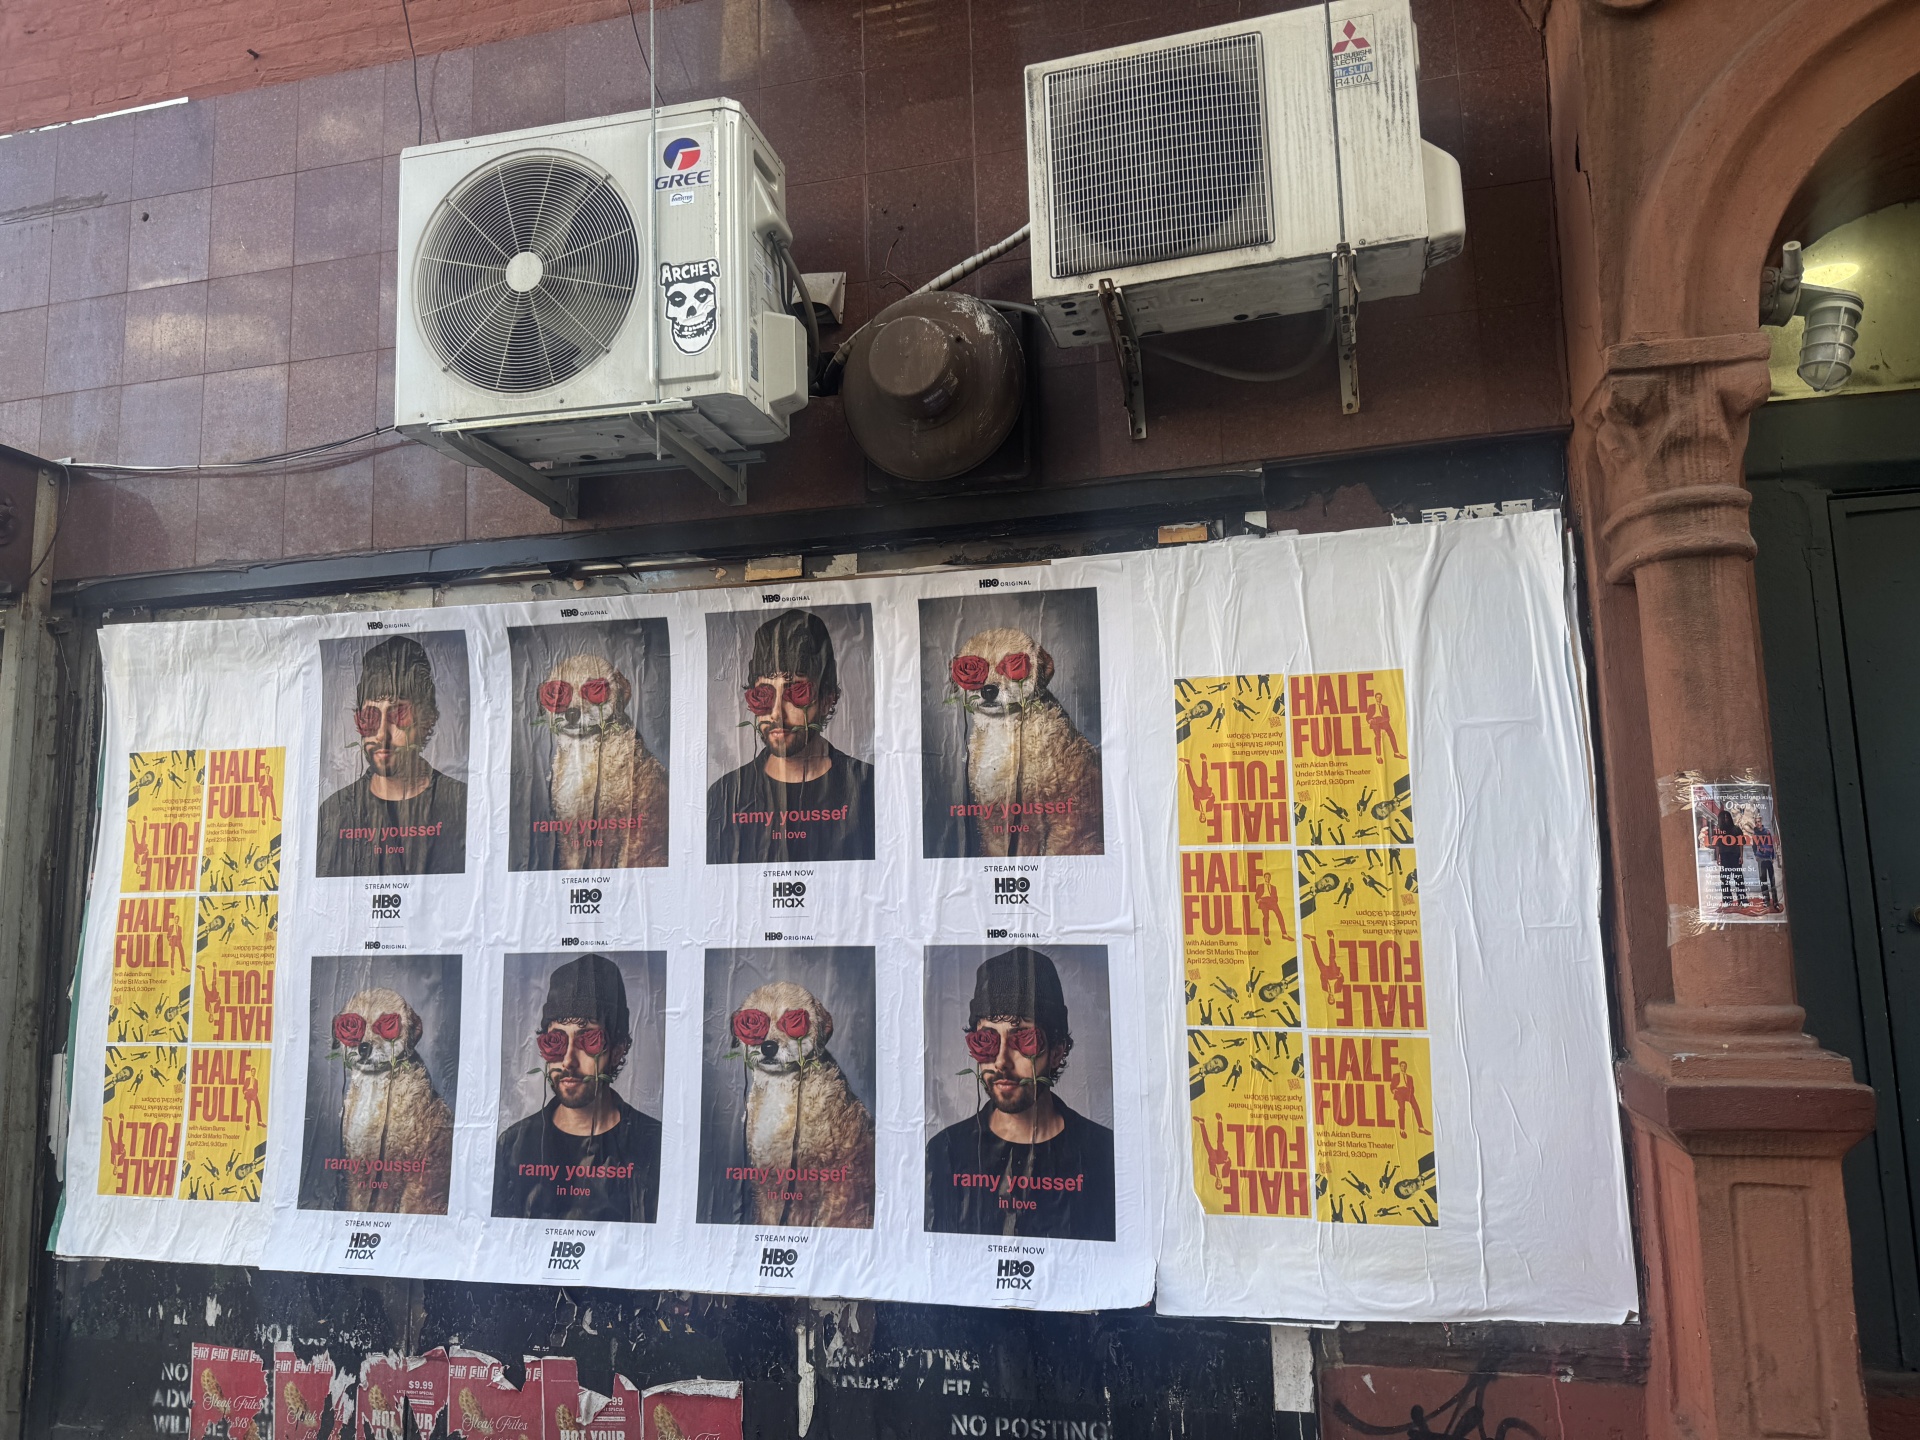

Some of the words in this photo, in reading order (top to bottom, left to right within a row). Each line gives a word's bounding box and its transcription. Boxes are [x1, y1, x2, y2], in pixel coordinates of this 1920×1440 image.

[1336, 74, 1370, 87] R410A
[655, 170, 710, 190] GREE
[661, 261, 718, 284] ARCHER
[979, 579, 999, 588] HBO
[762, 594, 781, 603] HBO
[561, 609, 579, 618] HBO
[367, 622, 384, 630] HBO
[1291, 673, 1374, 716] HALF
[1292, 716, 1372, 757] FULL
[210, 748, 267, 784] HALF
[1210, 760, 1287, 800] FULL
[207, 785, 260, 819] FULL
[949, 803, 994, 820] ramy
[1000, 798, 1074, 818] youssef
[732, 809, 774, 826] ramy
[779, 805, 848, 825] youssef
[339, 827, 377, 843] ramy
[381, 822, 443, 840] youssef
[533, 820, 572, 835] ramy
[577, 814, 643, 831] youssef
[1006, 822, 1030, 833] love
[148, 822, 200, 856] FULL
[772, 829, 782, 840] in
[784, 829, 807, 839] love
[373, 845, 382, 854] in
[385, 844, 405, 854] love
[1182, 852, 1263, 893] HALF
[772, 882, 806, 897] HBO
[994, 877, 1030, 893] HBO
[372, 894, 402, 909] HBO
[570, 888, 602, 904] HBO
[772, 897, 805, 908] max
[994, 893, 1029, 904] max
[117, 899, 176, 933] HALF
[372, 908, 401, 919] max
[570, 903, 600, 915] max
[1184, 895, 1260, 935] FULL
[561, 937, 579, 946] HBO
[765, 932, 783, 941] HBO
[987, 929, 1007, 938] HBO
[114, 934, 169, 968] FULL
[364, 941, 380, 950] HBO
[1338, 940, 1422, 982] FULL
[218, 970, 274, 1005] FULL
[191, 1050, 251, 1085] HALF
[1311, 1037, 1399, 1082] HALF
[189, 1086, 244, 1122] FULL
[1314, 1082, 1395, 1127] FULL
[126, 1122, 181, 1158] FULL
[1227, 1123, 1307, 1170] FULL
[324, 1158, 360, 1174] ramy
[364, 1158, 426, 1174] youssef
[518, 1163, 559, 1180] ramy
[565, 1163, 634, 1181] youssef
[726, 1166, 770, 1184] ramy
[775, 1165, 848, 1184] youssef
[556, 1185, 567, 1195] in
[570, 1185, 591, 1196] love
[952, 1171, 1001, 1192] ramy
[1006, 1173, 1084, 1193] youssef
[767, 1190, 778, 1200] in
[780, 1190, 803, 1200] love
[998, 1197, 1009, 1208] in
[1012, 1198, 1037, 1210] love
[349, 1232, 381, 1248] HBO
[754, 1235, 784, 1243] STREAM
[786, 1235, 809, 1243] NOW
[345, 1248, 374, 1260] max
[551, 1241, 586, 1258] HBO
[761, 1248, 798, 1265] HBO
[988, 1245, 1019, 1253] STREAM
[1021, 1246, 1045, 1254] NOW
[548, 1257, 581, 1270] max
[759, 1265, 795, 1278] max
[997, 1259, 1035, 1278] HBO
[996, 1277, 1032, 1290] max
[162, 1363, 188, 1381] NO
[409, 1381, 433, 1390] $9.99
[203, 1393, 231, 1411] Steak
[372, 1410, 395, 1426] NOT
[462, 1413, 495, 1431] Steak
[496, 1415, 528, 1432] Frites
[951, 1414, 988, 1436] NO
[995, 1417, 1110, 1440] POSTING
